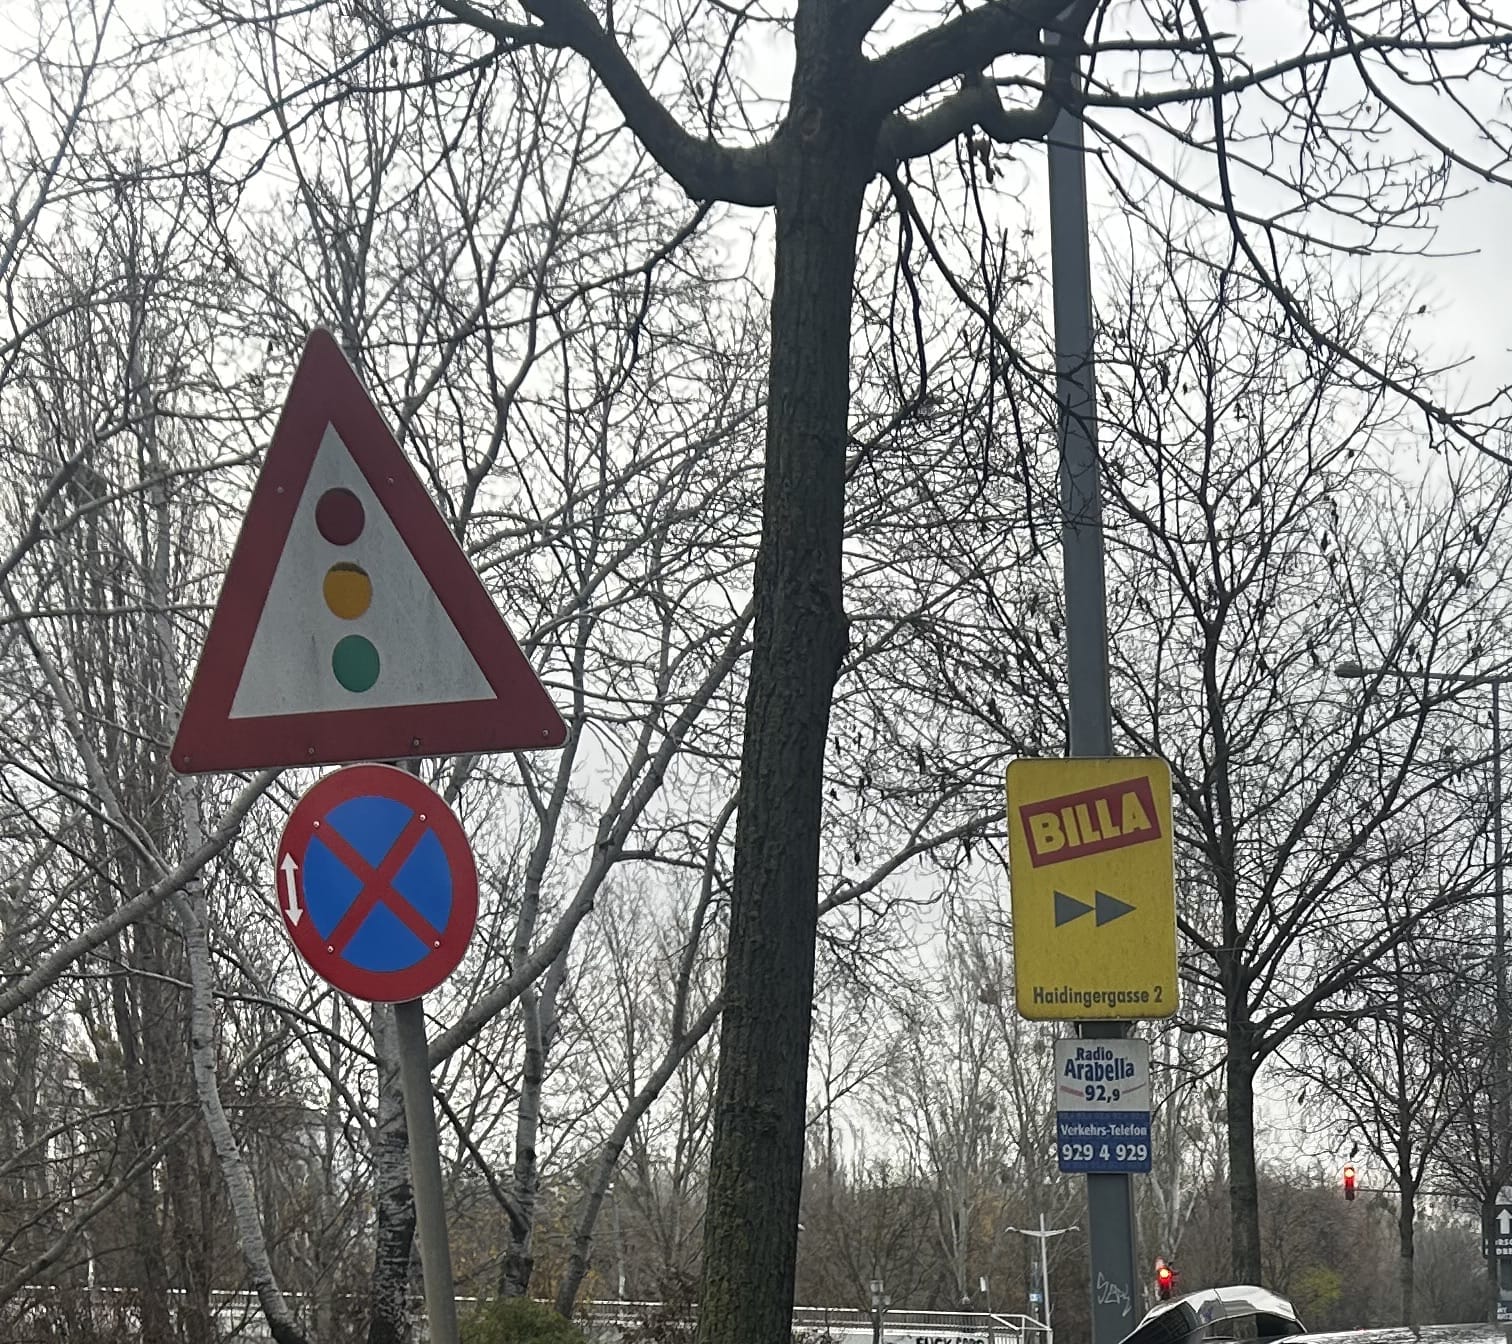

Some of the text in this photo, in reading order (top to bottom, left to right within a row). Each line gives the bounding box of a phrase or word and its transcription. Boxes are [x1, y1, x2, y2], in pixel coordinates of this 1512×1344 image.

[1029, 791, 1152, 855] BILLA
[1033, 986, 1163, 1007] Haidingergasse 2
[1075, 1047, 1114, 1061] Radio
[1064, 1057, 1135, 1082] Arabella
[1085, 1085, 1121, 1103] 92,9
[1060, 1124, 1148, 1136] Verkehrs-Telefon
[1062, 1143, 1148, 1161] 929 4 929
